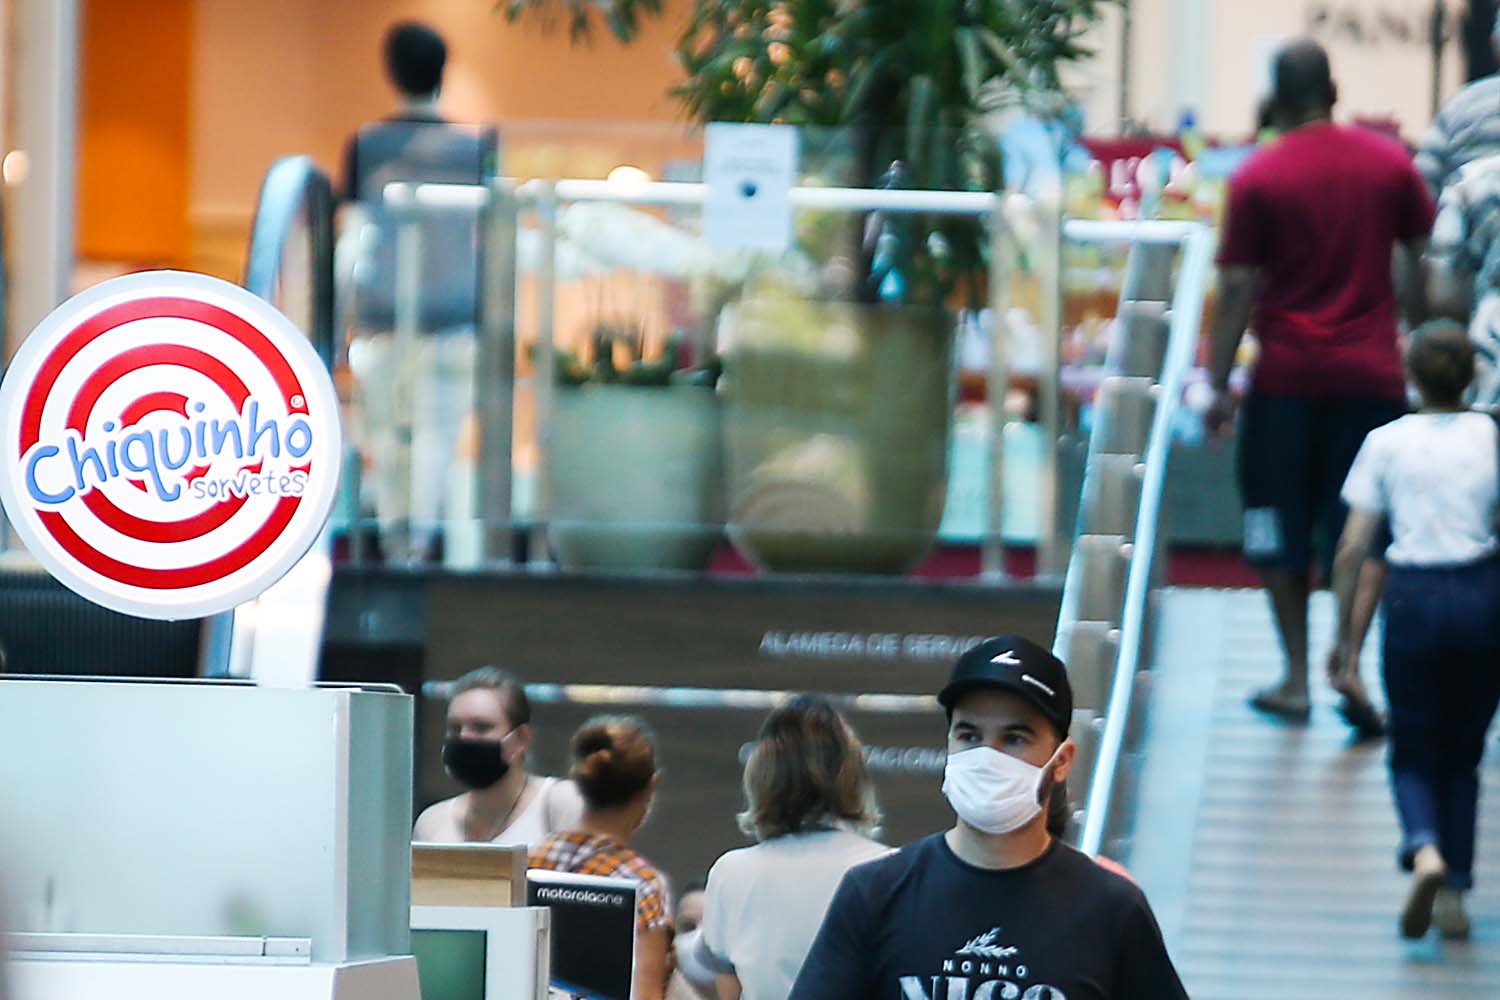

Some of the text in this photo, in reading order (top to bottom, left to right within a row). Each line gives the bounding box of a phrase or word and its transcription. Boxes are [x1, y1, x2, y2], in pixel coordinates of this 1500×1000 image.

[26, 401, 313, 504] Chiquinho
[194, 471, 305, 499] sorvetes
[942, 959, 1029, 978] NONNO
